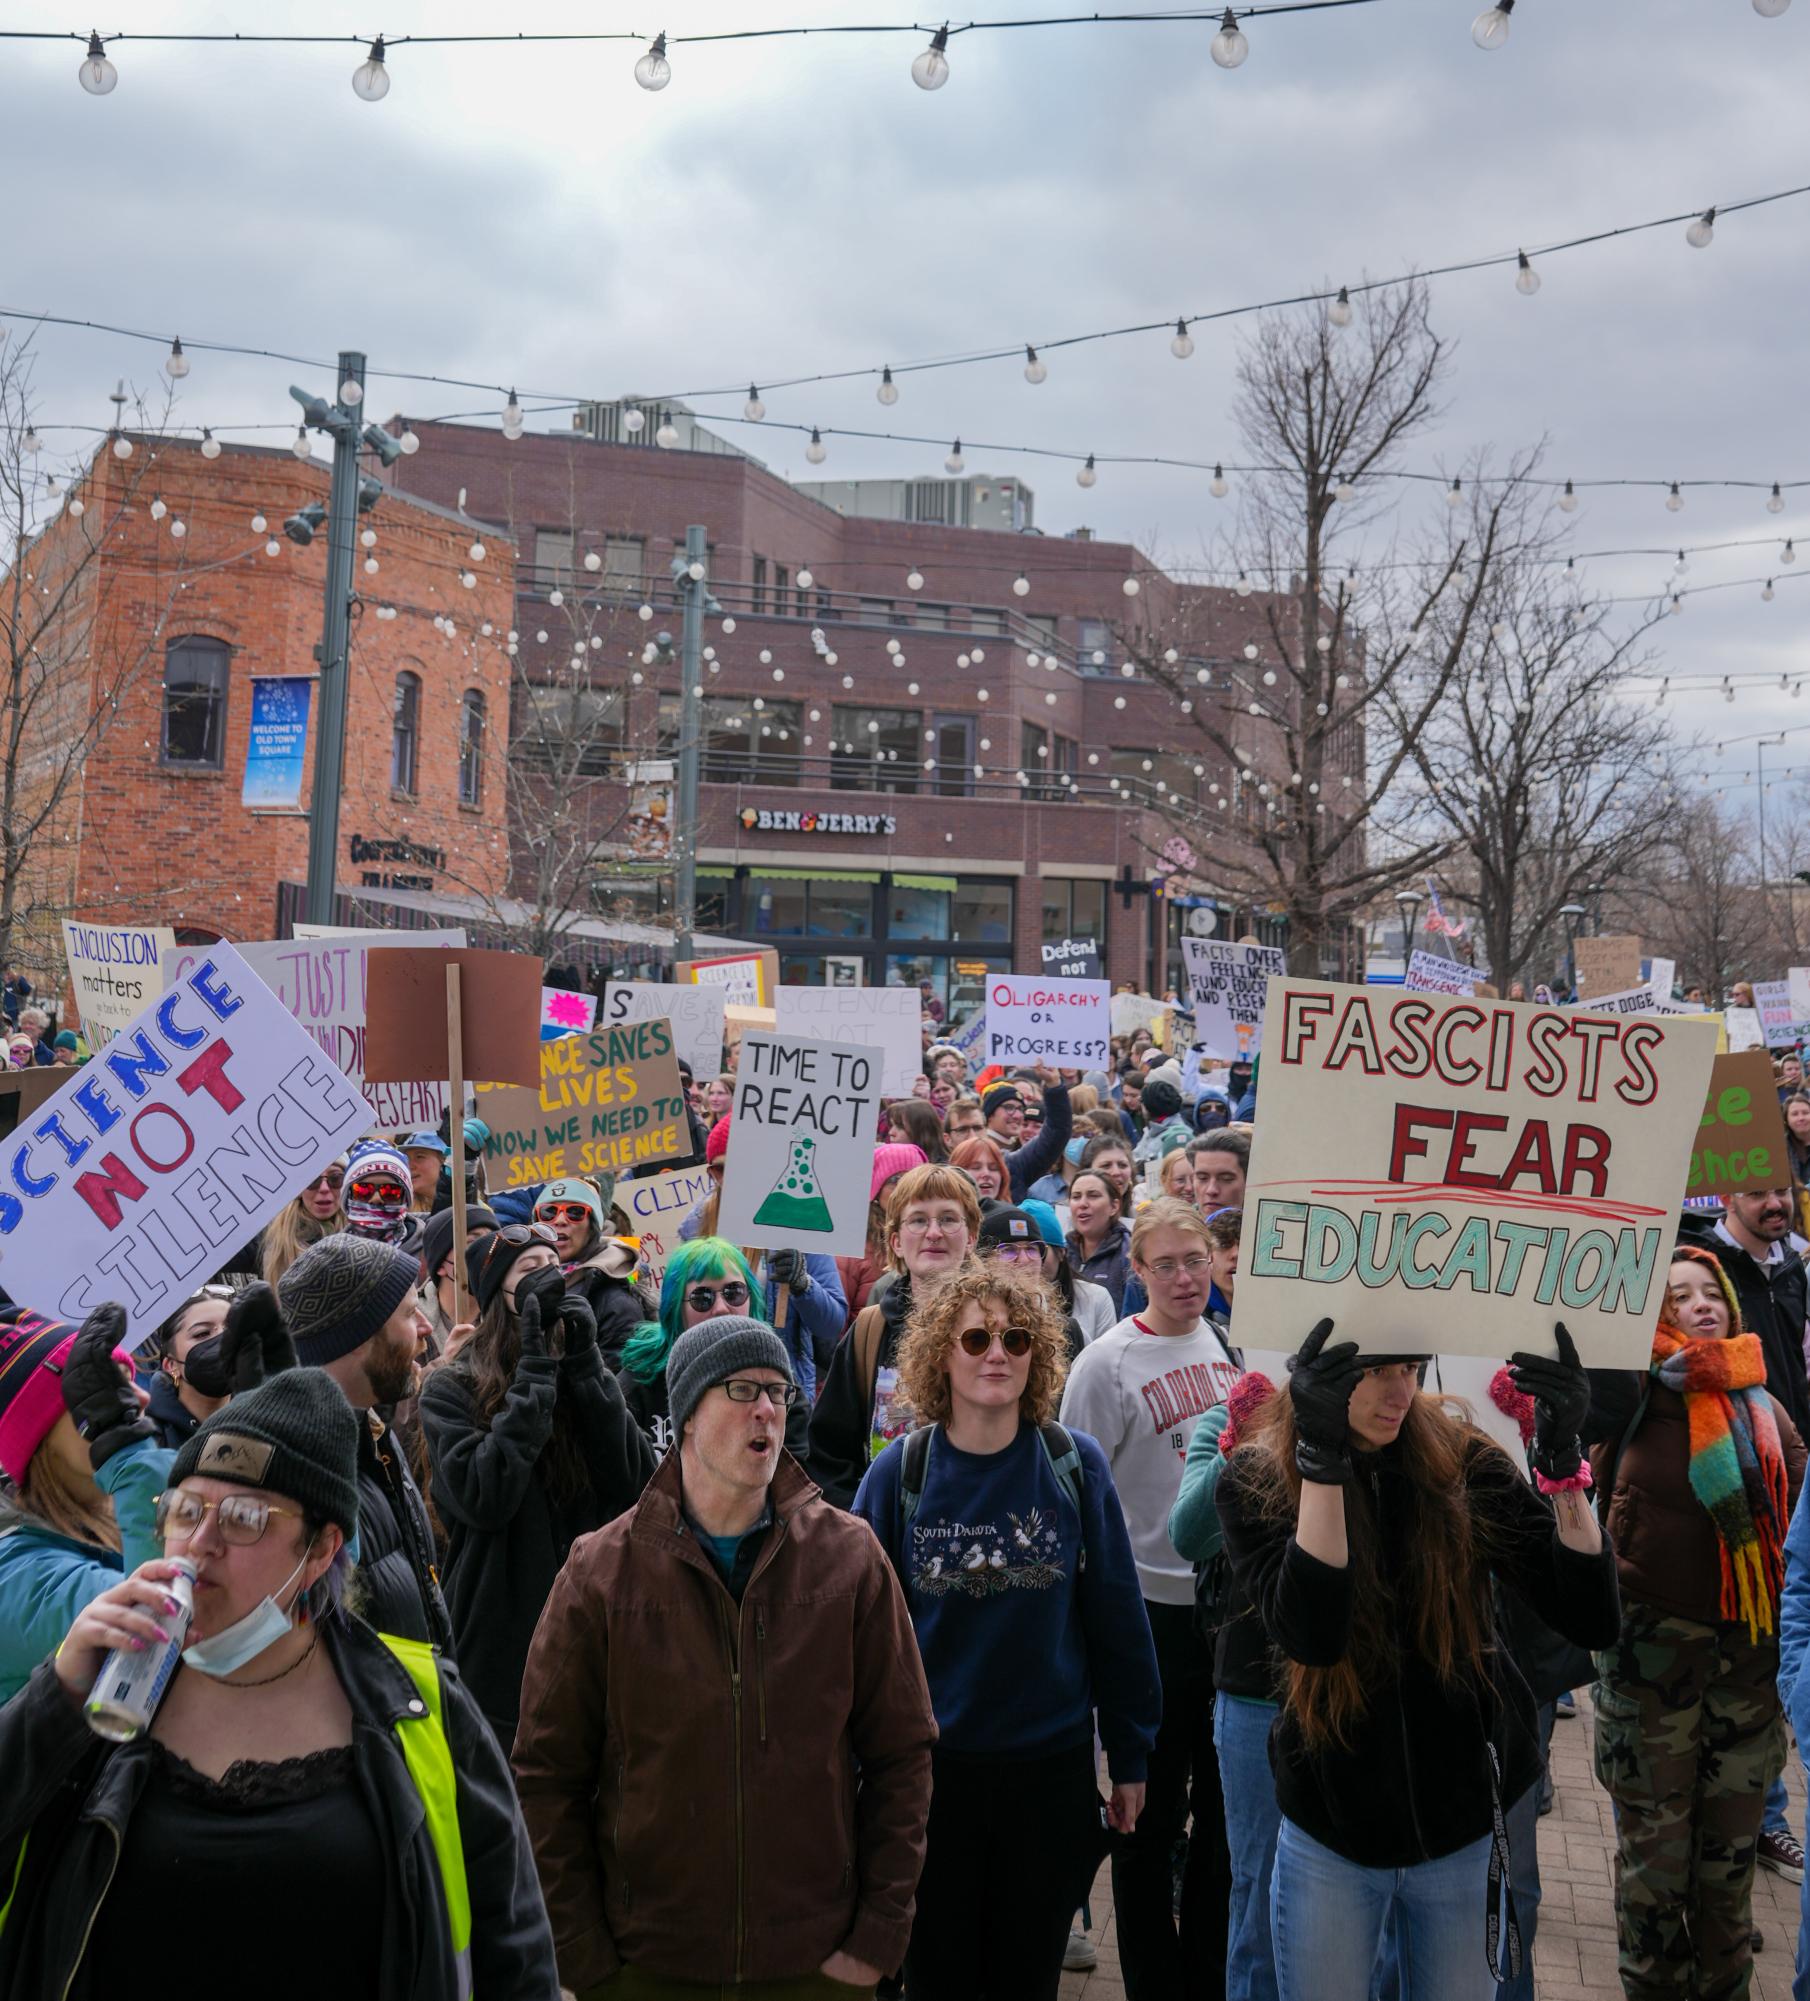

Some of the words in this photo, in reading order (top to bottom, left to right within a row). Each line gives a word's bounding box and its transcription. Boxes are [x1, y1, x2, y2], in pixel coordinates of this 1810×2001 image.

[253, 725, 290, 734] WELCOME
[292, 724, 303, 733] TO
[255, 736, 273, 744] OLD
[274, 735, 297, 744] TOWN
[259, 745, 291, 755] SQUARE
[758, 810, 800, 829] BEN
[816, 812, 897, 834] JERRY'S
[68, 927, 158, 965] INCLUSION
[1041, 938, 1096, 962] Defend
[1191, 943, 1235, 961] FACTS
[1245, 948, 1283, 968] OVER
[82, 967, 142, 999] matters
[276, 949, 350, 1018] JUST
[1060, 961, 1087, 976] not
[1190, 974, 1227, 991] FUND
[610, 989, 699, 1021] SAVE
[780, 989, 917, 1015] SCIENCE
[993, 984, 1099, 1007] OLIGARCHY
[1196, 991, 1220, 1005] AND
[1620, 992, 1655, 1014] DOGE
[1031, 1012, 1054, 1023] OR
[588, 1022, 671, 1068] SAVES
[992, 1033, 1106, 1061] PROGRESS?
[1281, 991, 1665, 1106] FASCISTS
[747, 1041, 817, 1083] TIME
[831, 1053, 870, 1092] TO
[539, 1067, 638, 1113] LIVES
[739, 1084, 870, 1138] REACT
[73, 1037, 246, 1231] NOT
[486, 1129, 537, 1160] NOW
[544, 1116, 581, 1147] WE
[592, 1106, 649, 1140] NEED
[652, 1096, 683, 1121] TO
[506, 1148, 567, 1186] SAVE
[578, 1124, 679, 1173] SCIENCE
[1388, 1102, 1612, 1197] FEAR
[58, 1056, 357, 1319] SILENCE
[1251, 1198, 1661, 1315] EDUCATION
[1141, 1363, 1218, 1435] COLORADO
[913, 1525, 951, 1544] SOUTH
[951, 1523, 998, 1538] DAKOTA
